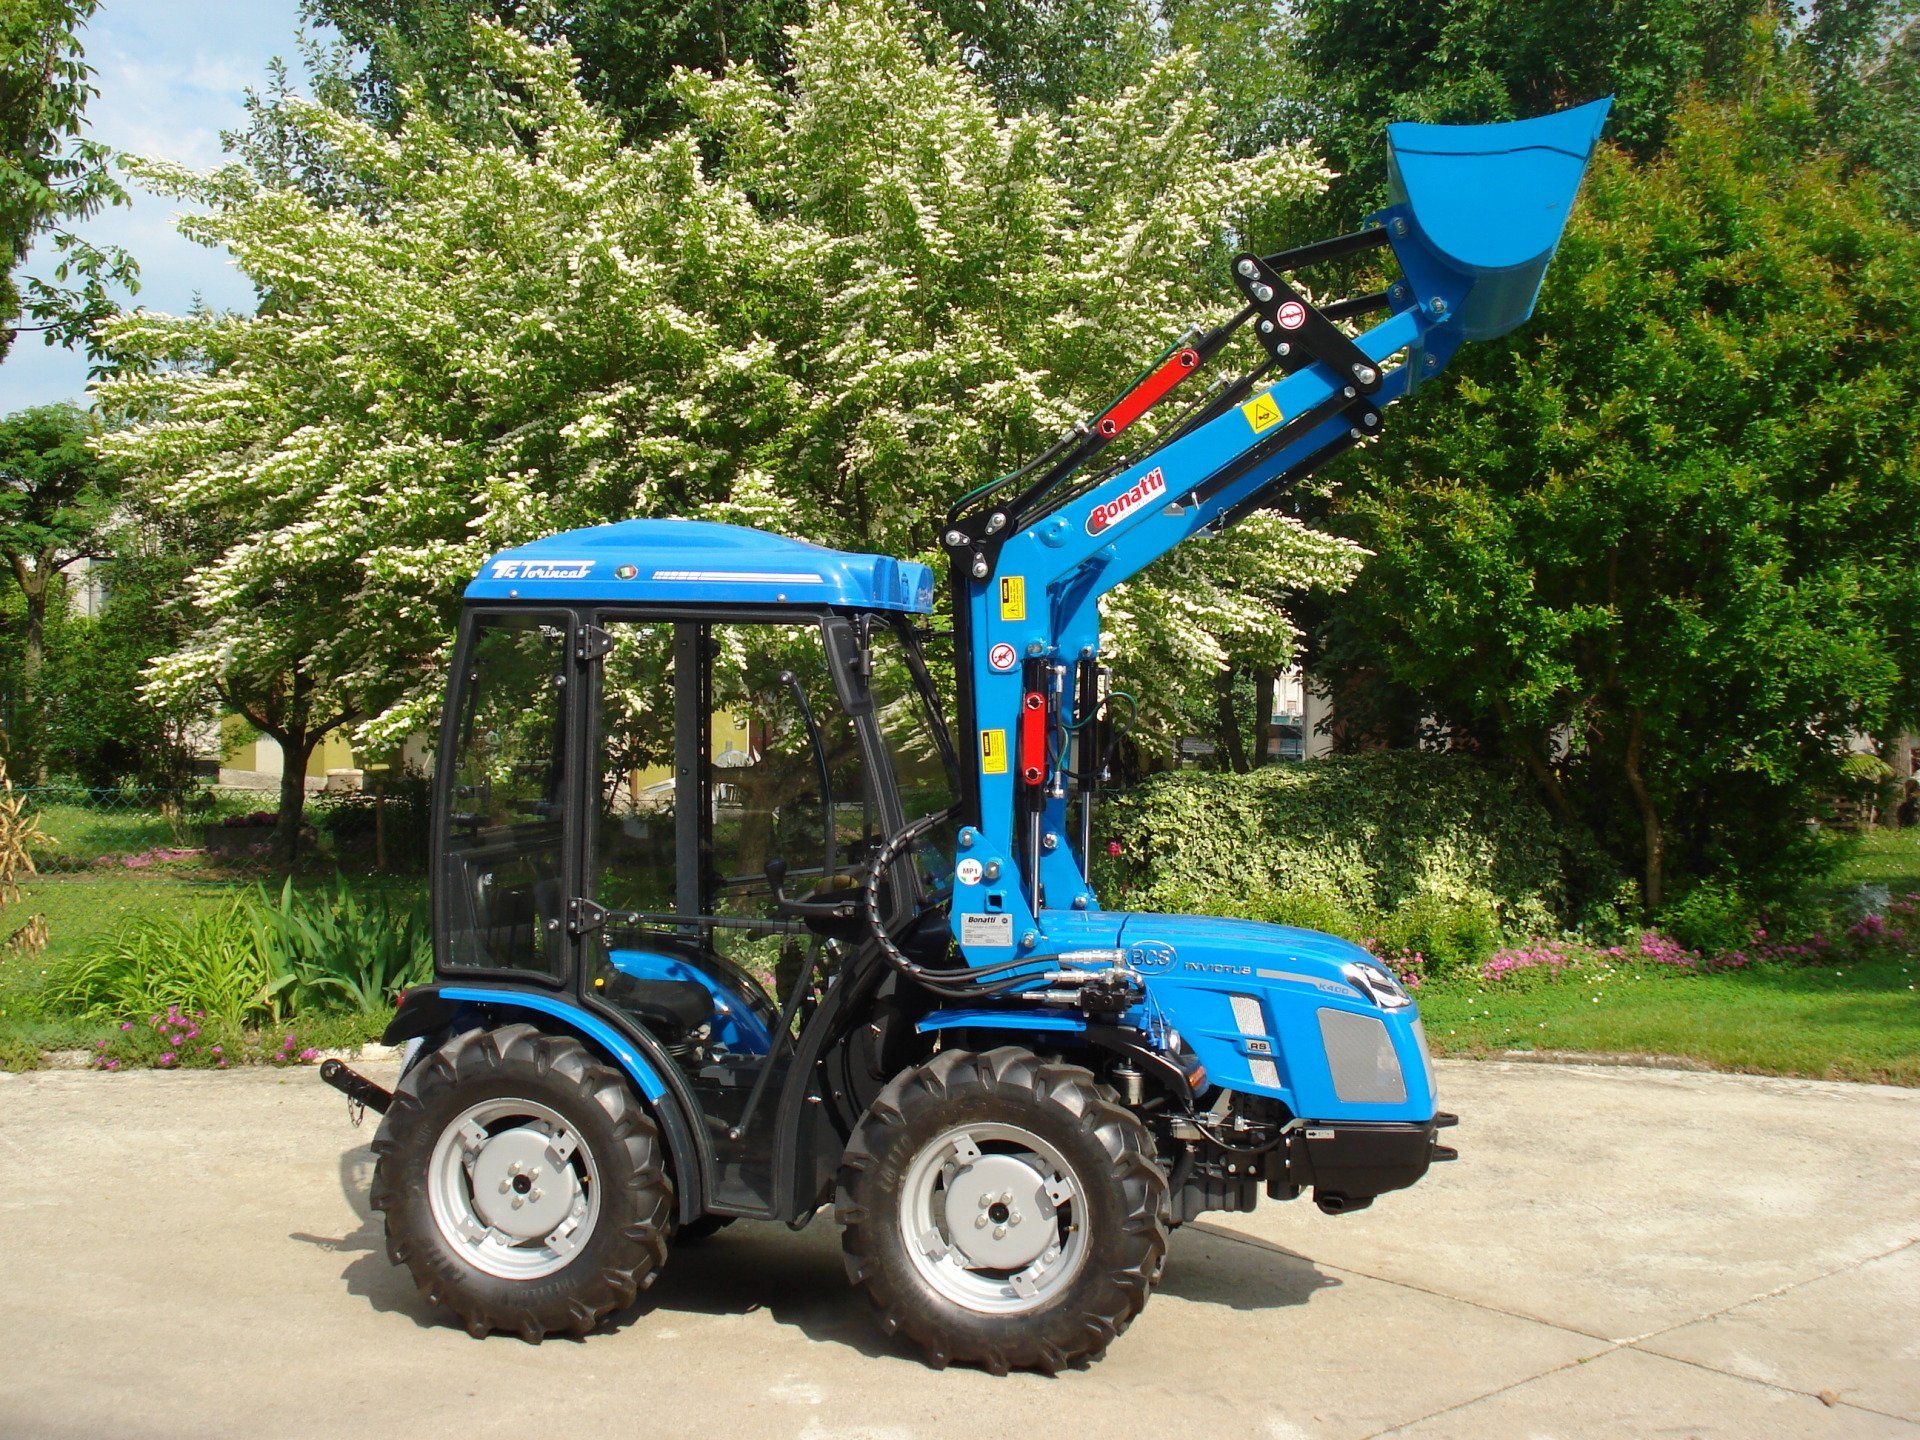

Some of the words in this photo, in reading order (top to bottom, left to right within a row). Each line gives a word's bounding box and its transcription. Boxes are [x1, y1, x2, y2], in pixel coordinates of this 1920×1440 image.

[1091, 467, 1164, 529] Bonatti
[967, 916, 997, 924] Bonatti
[1131, 949, 1171, 966] BCS
[1318, 983, 1349, 995] K400
